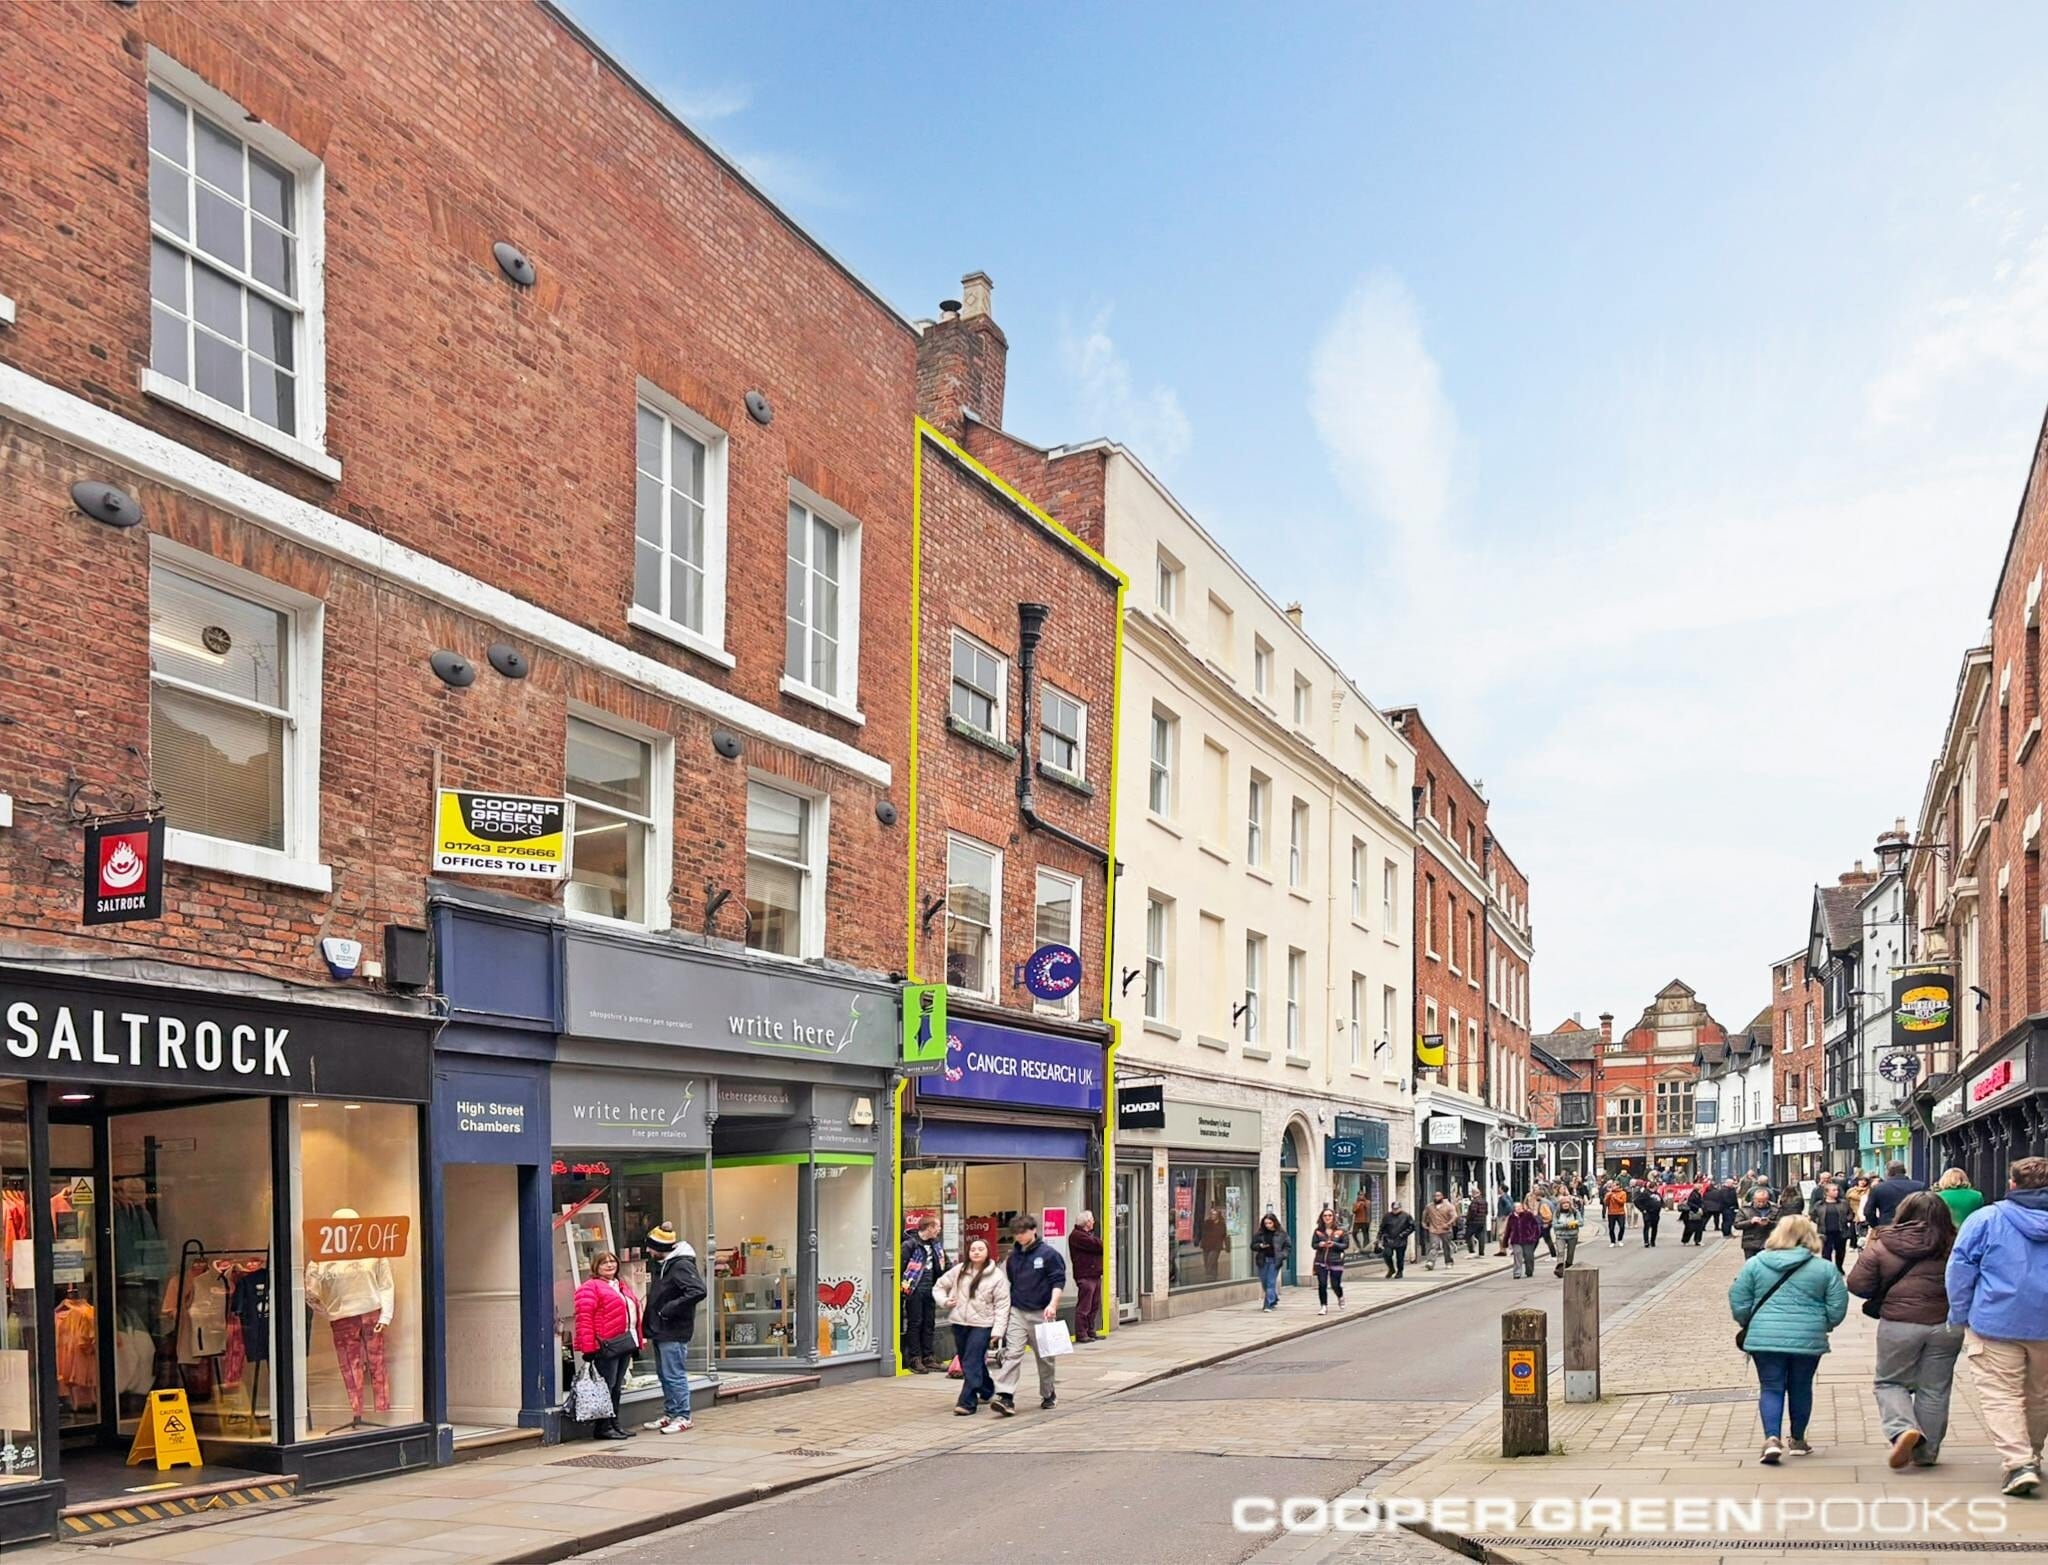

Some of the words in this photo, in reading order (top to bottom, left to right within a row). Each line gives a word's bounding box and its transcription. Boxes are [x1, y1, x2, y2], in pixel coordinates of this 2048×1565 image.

[472, 798, 560, 815] COOPER
[471, 809, 542, 824] GREEN
[471, 821, 542, 835] POOKS
[444, 841, 491, 852] 01743
[497, 845, 556, 858] 276666
[441, 856, 503, 868] OFFICES
[506, 861, 525, 870] TO
[530, 862, 557, 873] LET
[97, 895, 146, 912] SALTROCK
[6, 1001, 291, 1077] SALTROCK
[728, 1014, 784, 1040] write
[792, 1018, 836, 1047] here
[967, 1051, 1018, 1077] CANCER
[1020, 1059, 1076, 1084] RESEARCH
[1078, 1068, 1094, 1086] UK
[717, 1089, 789, 1104] iteherepens.co.uk
[456, 1101, 485, 1117] High
[489, 1103, 525, 1117] Street
[573, 1101, 621, 1120] write
[629, 1102, 666, 1122] here
[1121, 1101, 1160, 1114] HOWDEN
[460, 1118, 521, 1133] Chambers
[632, 1128, 645, 1137] fine
[647, 1130, 659, 1138] pen
[660, 1129, 687, 1139] retailers
[319, 1223, 363, 1254] 20%
[367, 1223, 400, 1252] Off
